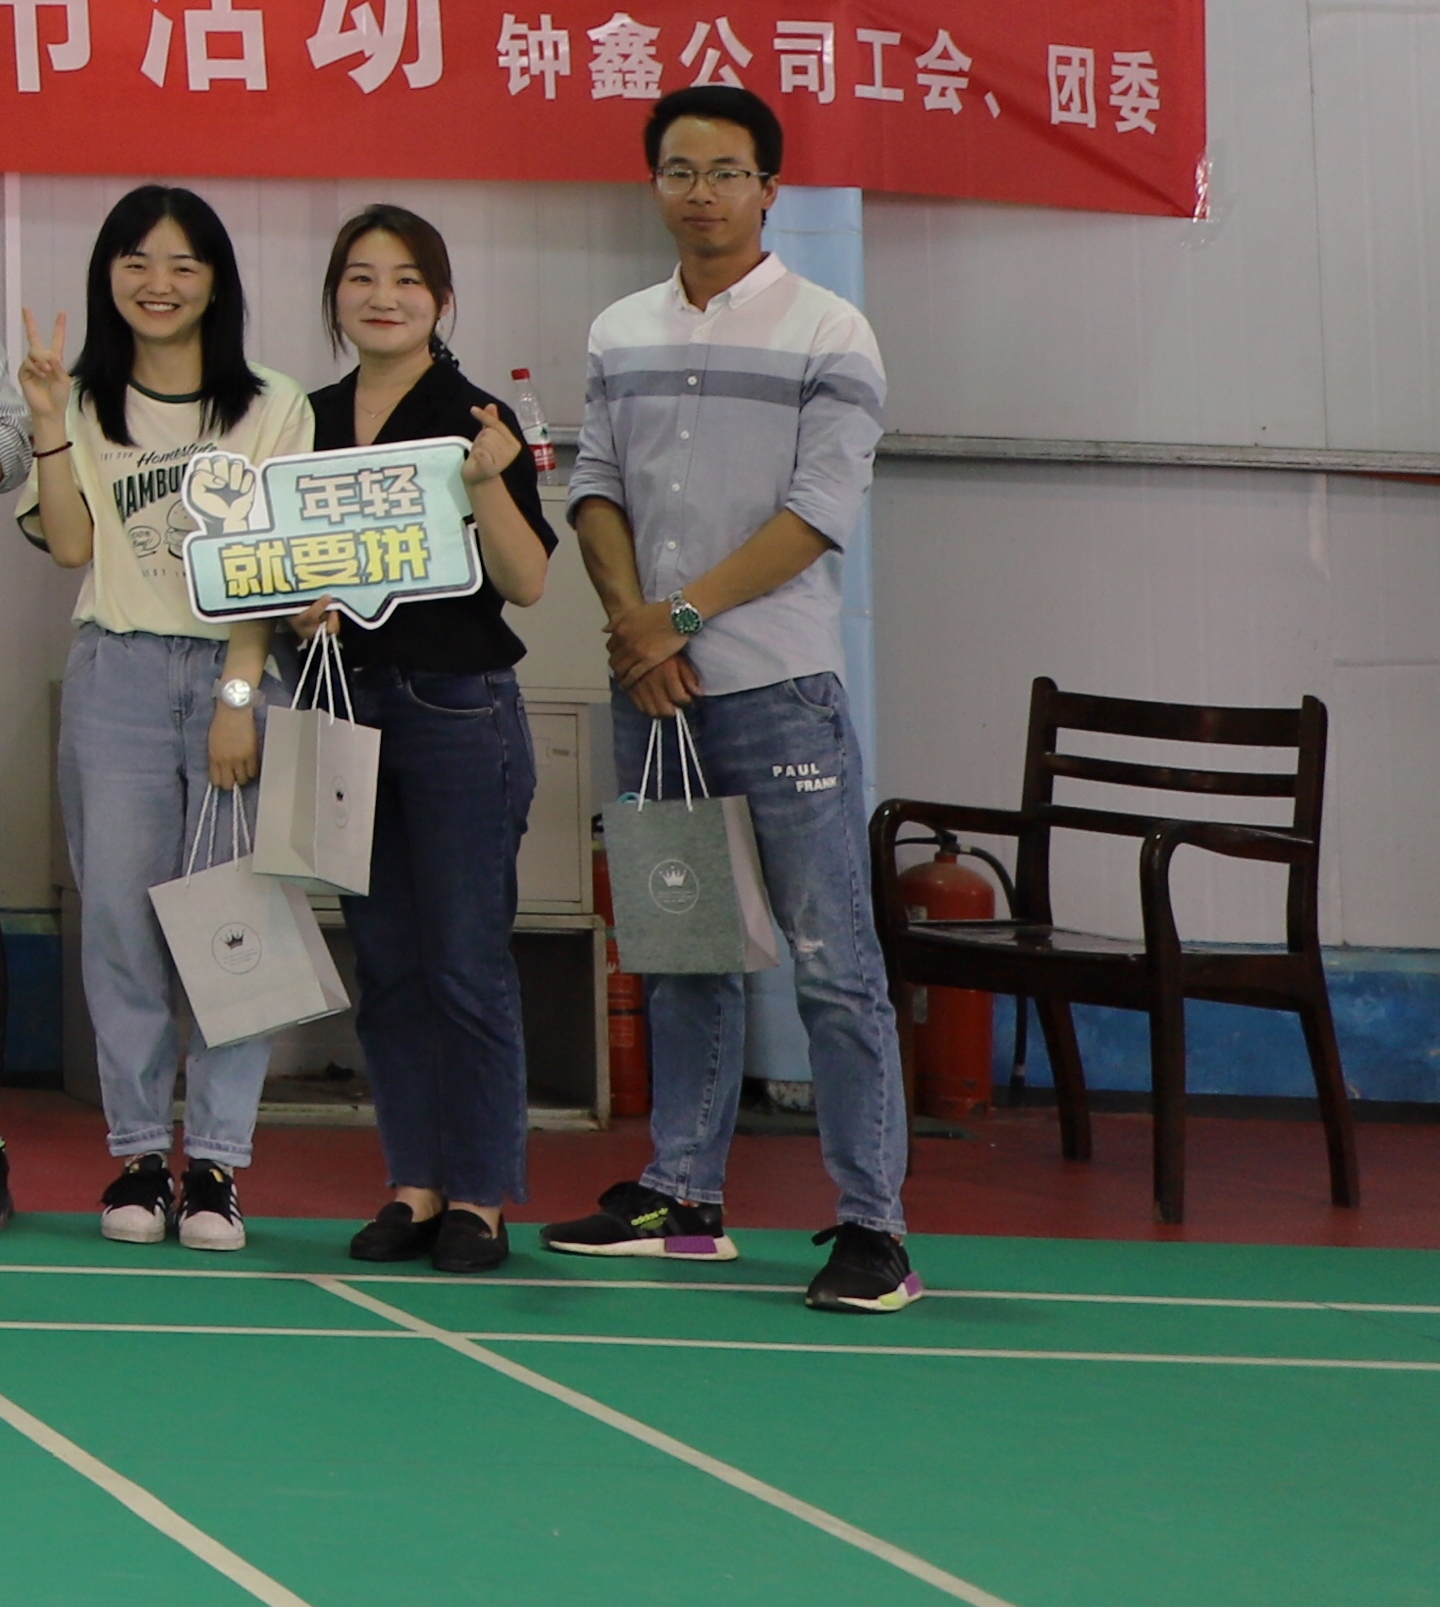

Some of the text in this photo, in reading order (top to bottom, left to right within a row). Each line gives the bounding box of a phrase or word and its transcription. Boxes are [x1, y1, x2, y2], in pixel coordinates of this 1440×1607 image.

[297, 465, 425, 523] 年轻
[219, 523, 429, 599] 就要拼
[772, 762, 820, 778] PAUL
